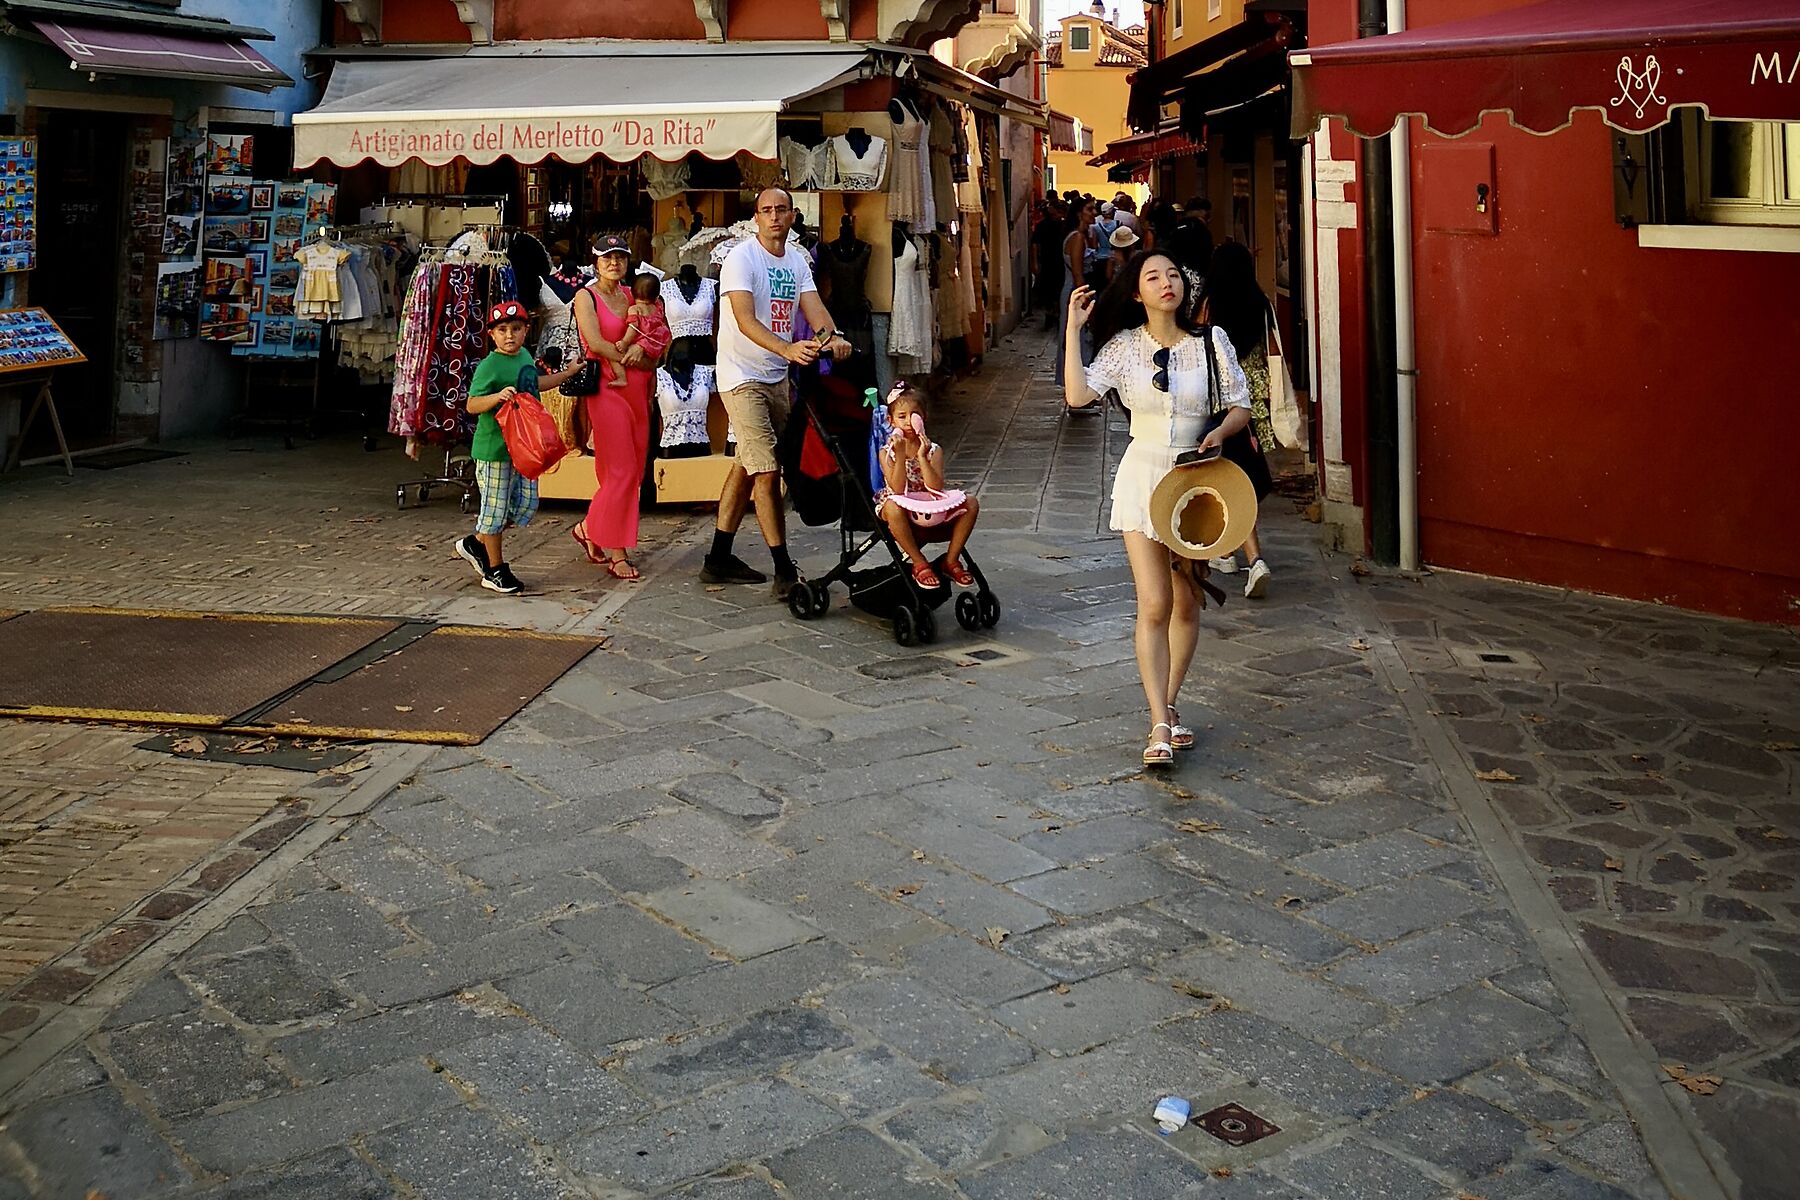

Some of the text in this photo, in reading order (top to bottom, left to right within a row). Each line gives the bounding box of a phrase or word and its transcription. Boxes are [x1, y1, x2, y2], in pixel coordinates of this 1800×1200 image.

[349, 128, 465, 160] Artigianato
[473, 124, 504, 150] del
[513, 121, 604, 150] Merletto
